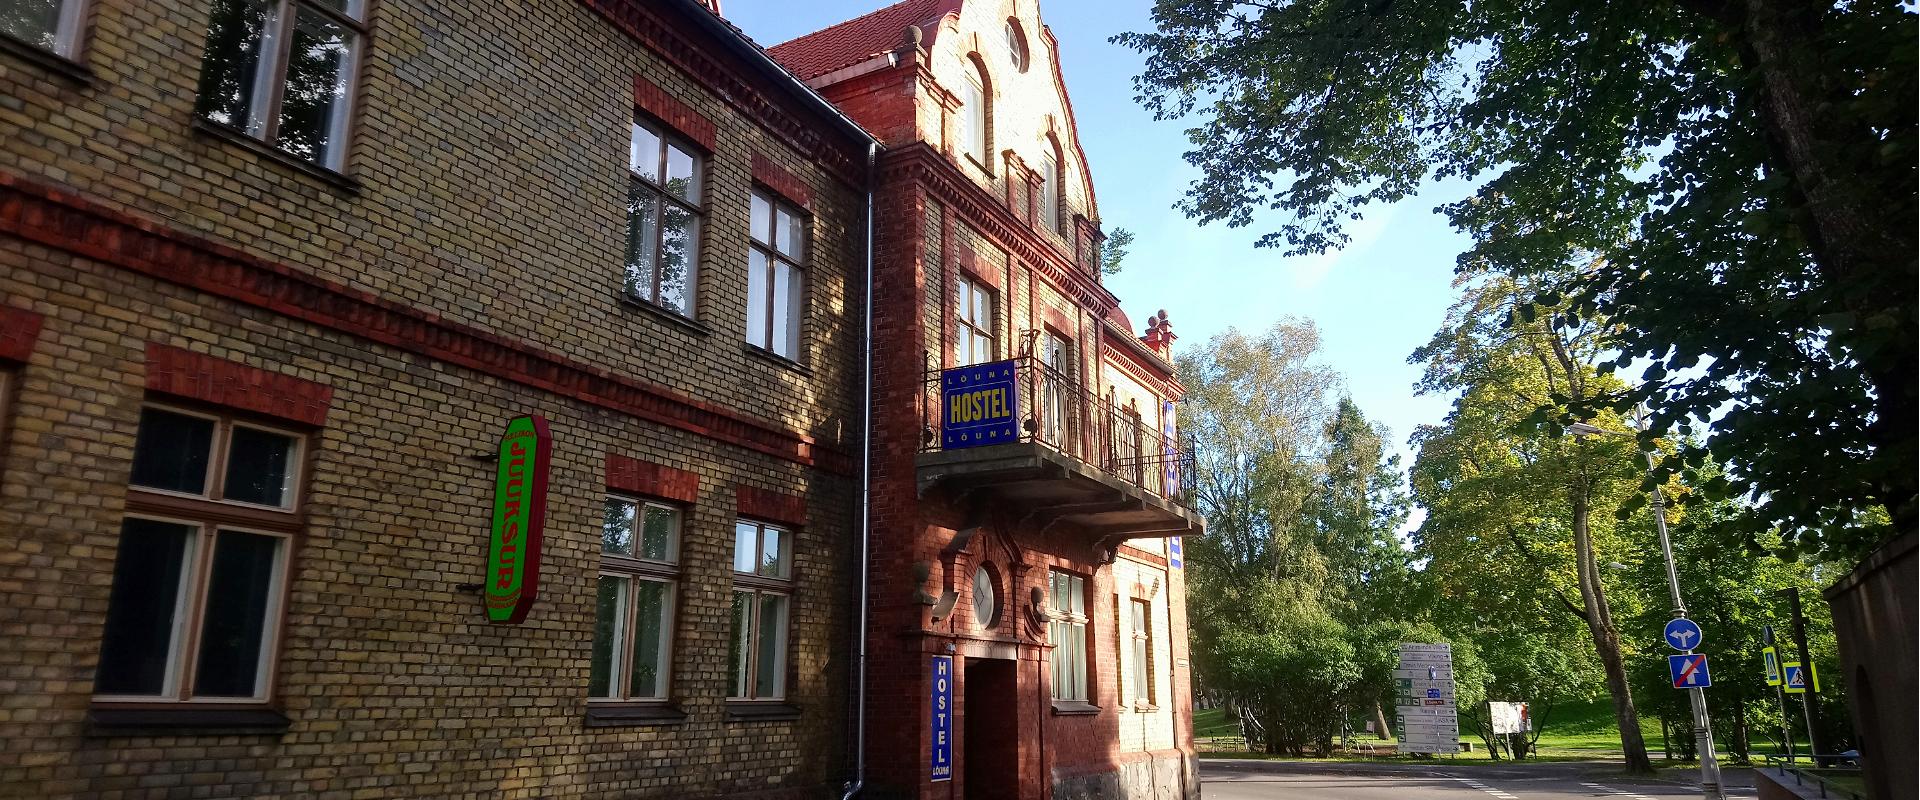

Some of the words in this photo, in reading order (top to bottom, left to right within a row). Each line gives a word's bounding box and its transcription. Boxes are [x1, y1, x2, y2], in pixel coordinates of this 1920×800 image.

[950, 387, 1010, 424] HOSTEL
[496, 441, 526, 590] JUUKSUR
[937, 661, 947, 763] HOSTEL
